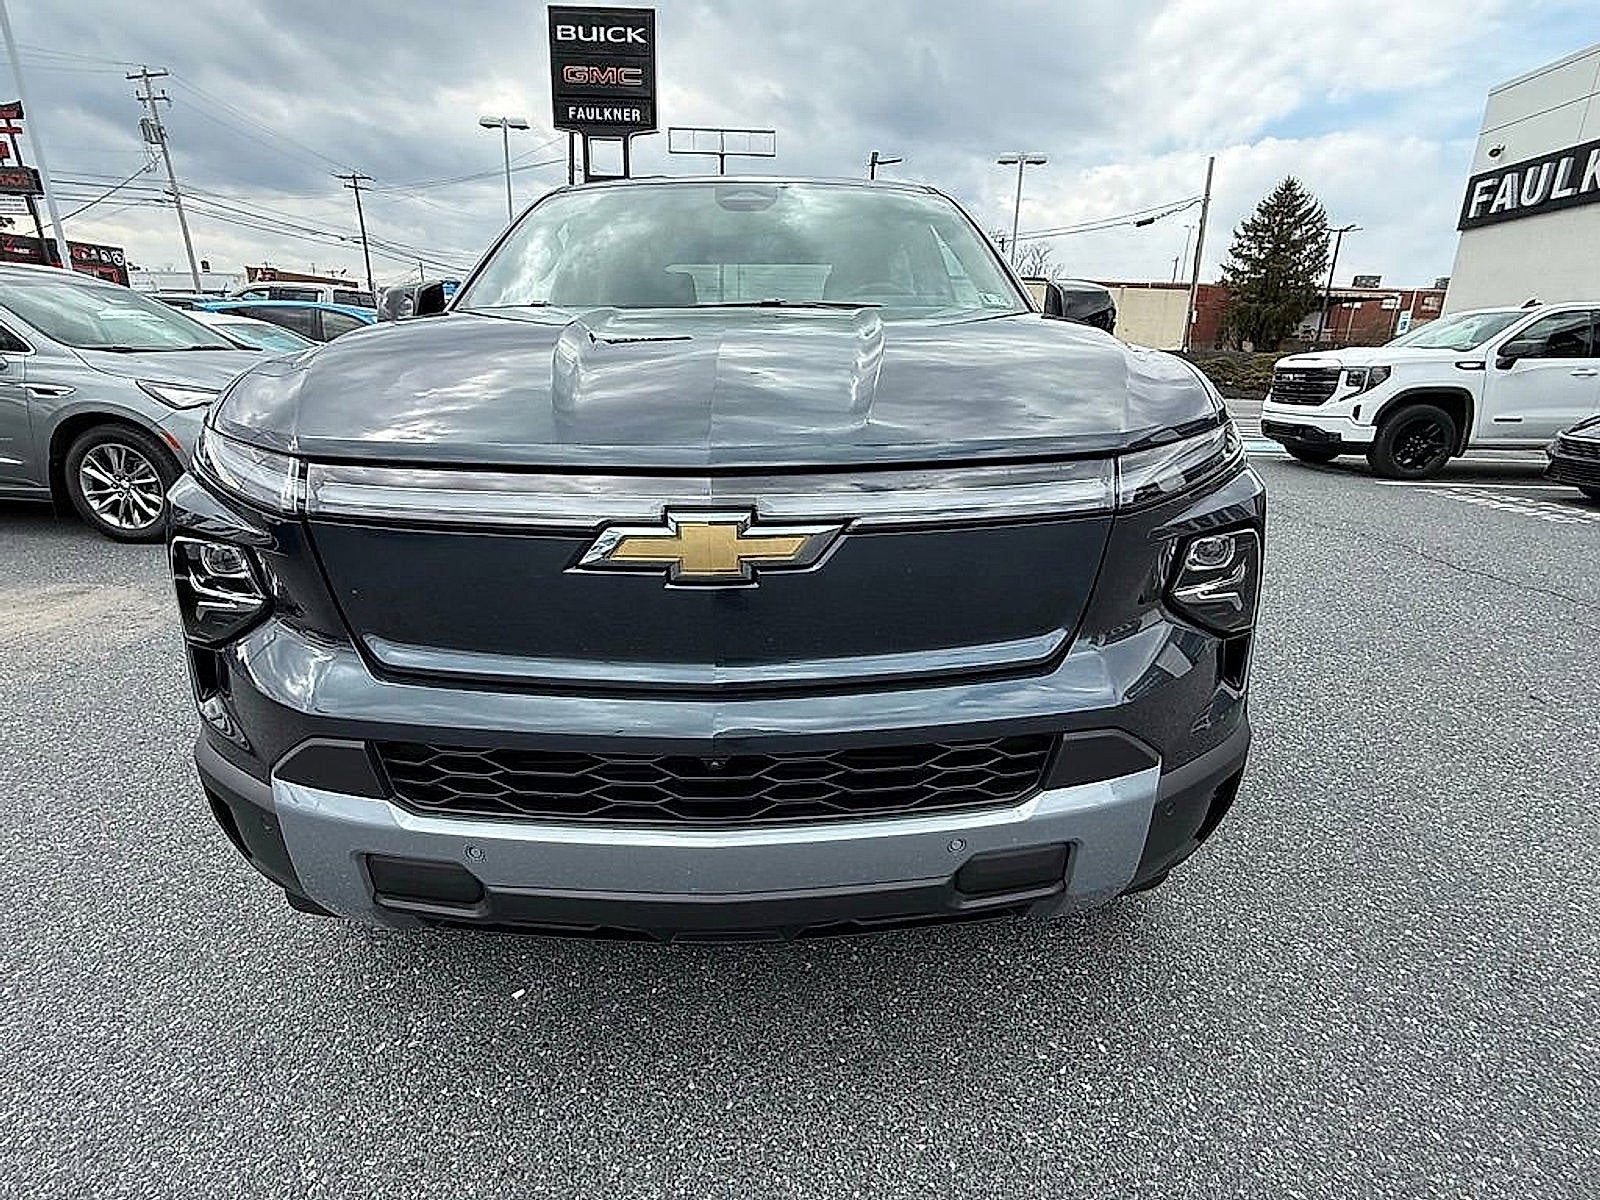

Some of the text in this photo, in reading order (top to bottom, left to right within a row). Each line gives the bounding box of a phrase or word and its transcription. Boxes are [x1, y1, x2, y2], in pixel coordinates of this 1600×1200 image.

[556, 25, 648, 43] BUICK
[563, 66, 642, 86] GMC
[568, 106, 641, 122] FAULKNER
